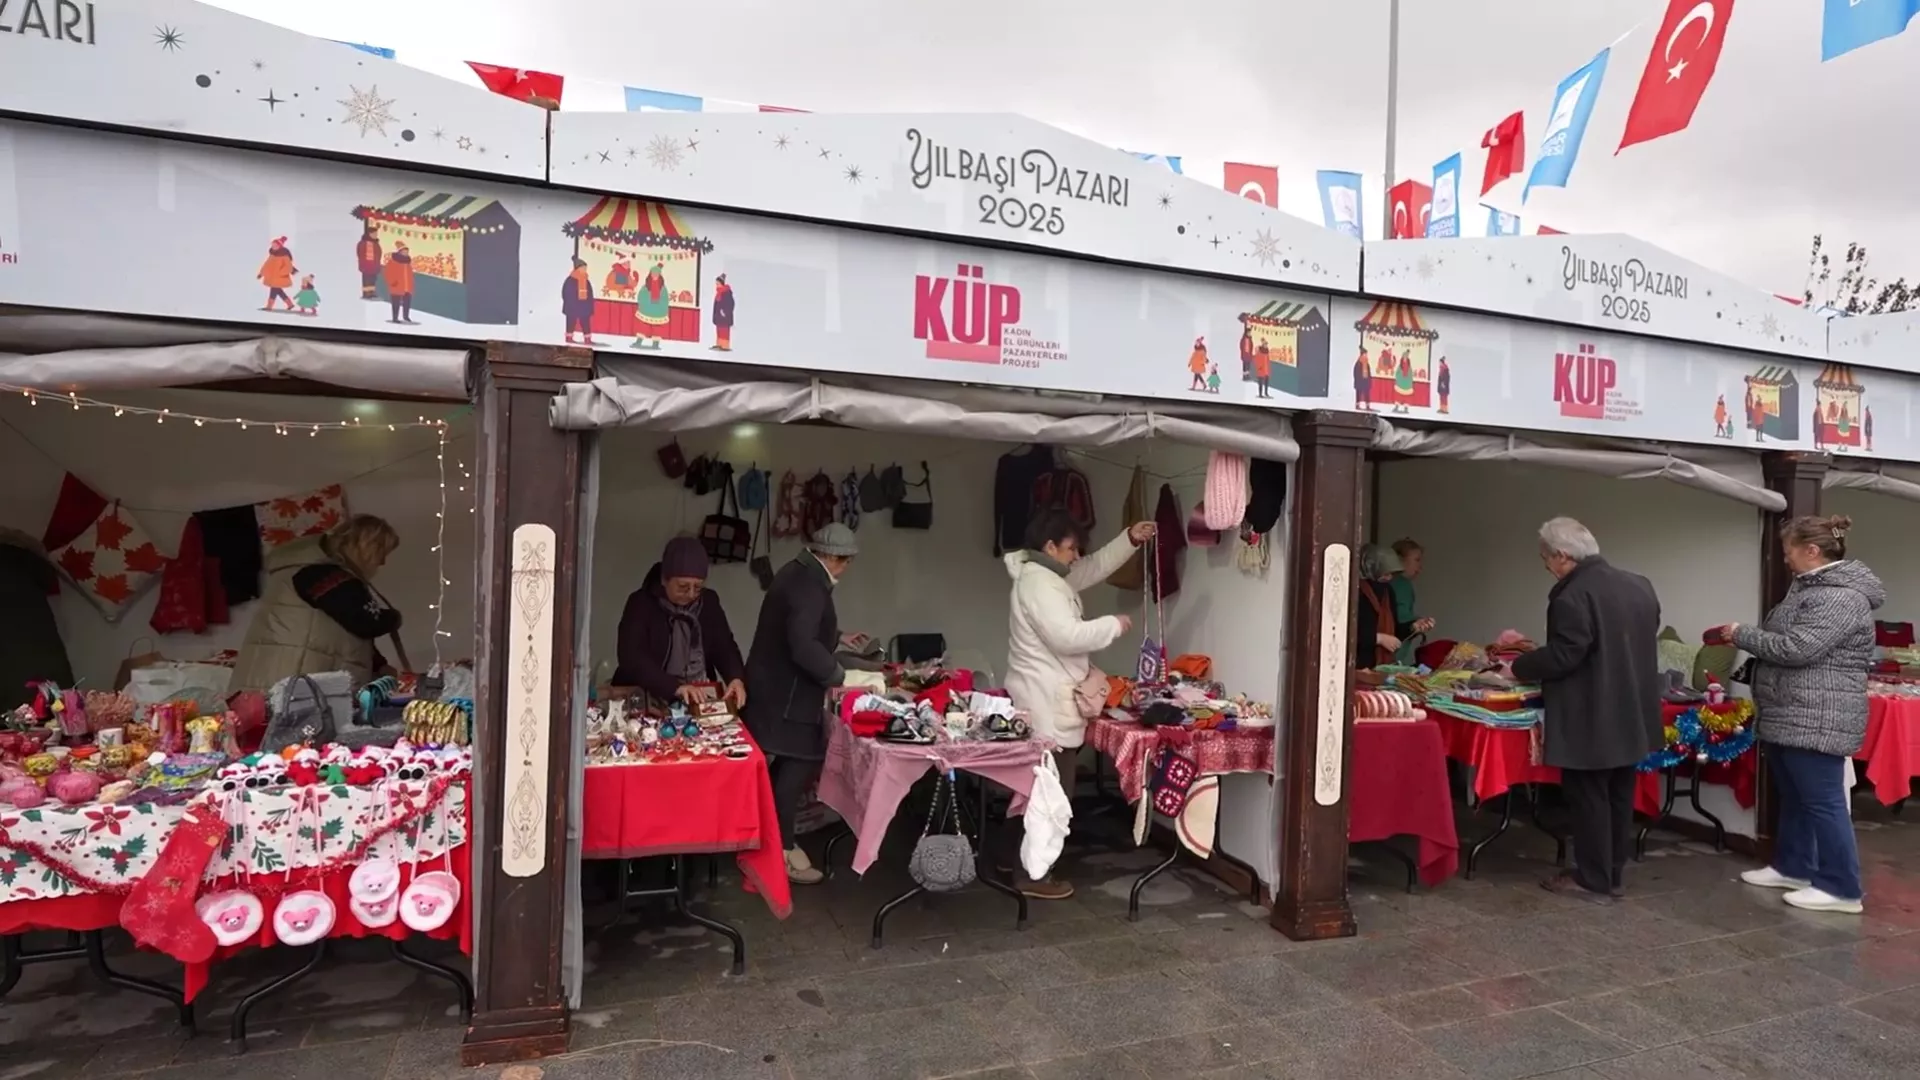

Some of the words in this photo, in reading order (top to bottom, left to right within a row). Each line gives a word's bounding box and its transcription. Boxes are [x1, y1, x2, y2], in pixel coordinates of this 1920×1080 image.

[906, 128, 1016, 193] YILBAŞI
[1021, 149, 1129, 207] PAZARI
[979, 194, 1065, 235] 2025
[1561, 245, 1623, 293] YILBAŞI
[1624, 258, 1688, 299] PAZARI
[913, 263, 1021, 346] KÜP
[1601, 294, 1651, 323] 2025
[1003, 328, 1031, 337] KADIN
[1003, 337, 1015, 346] EL
[1553, 343, 1617, 406] KÜP
